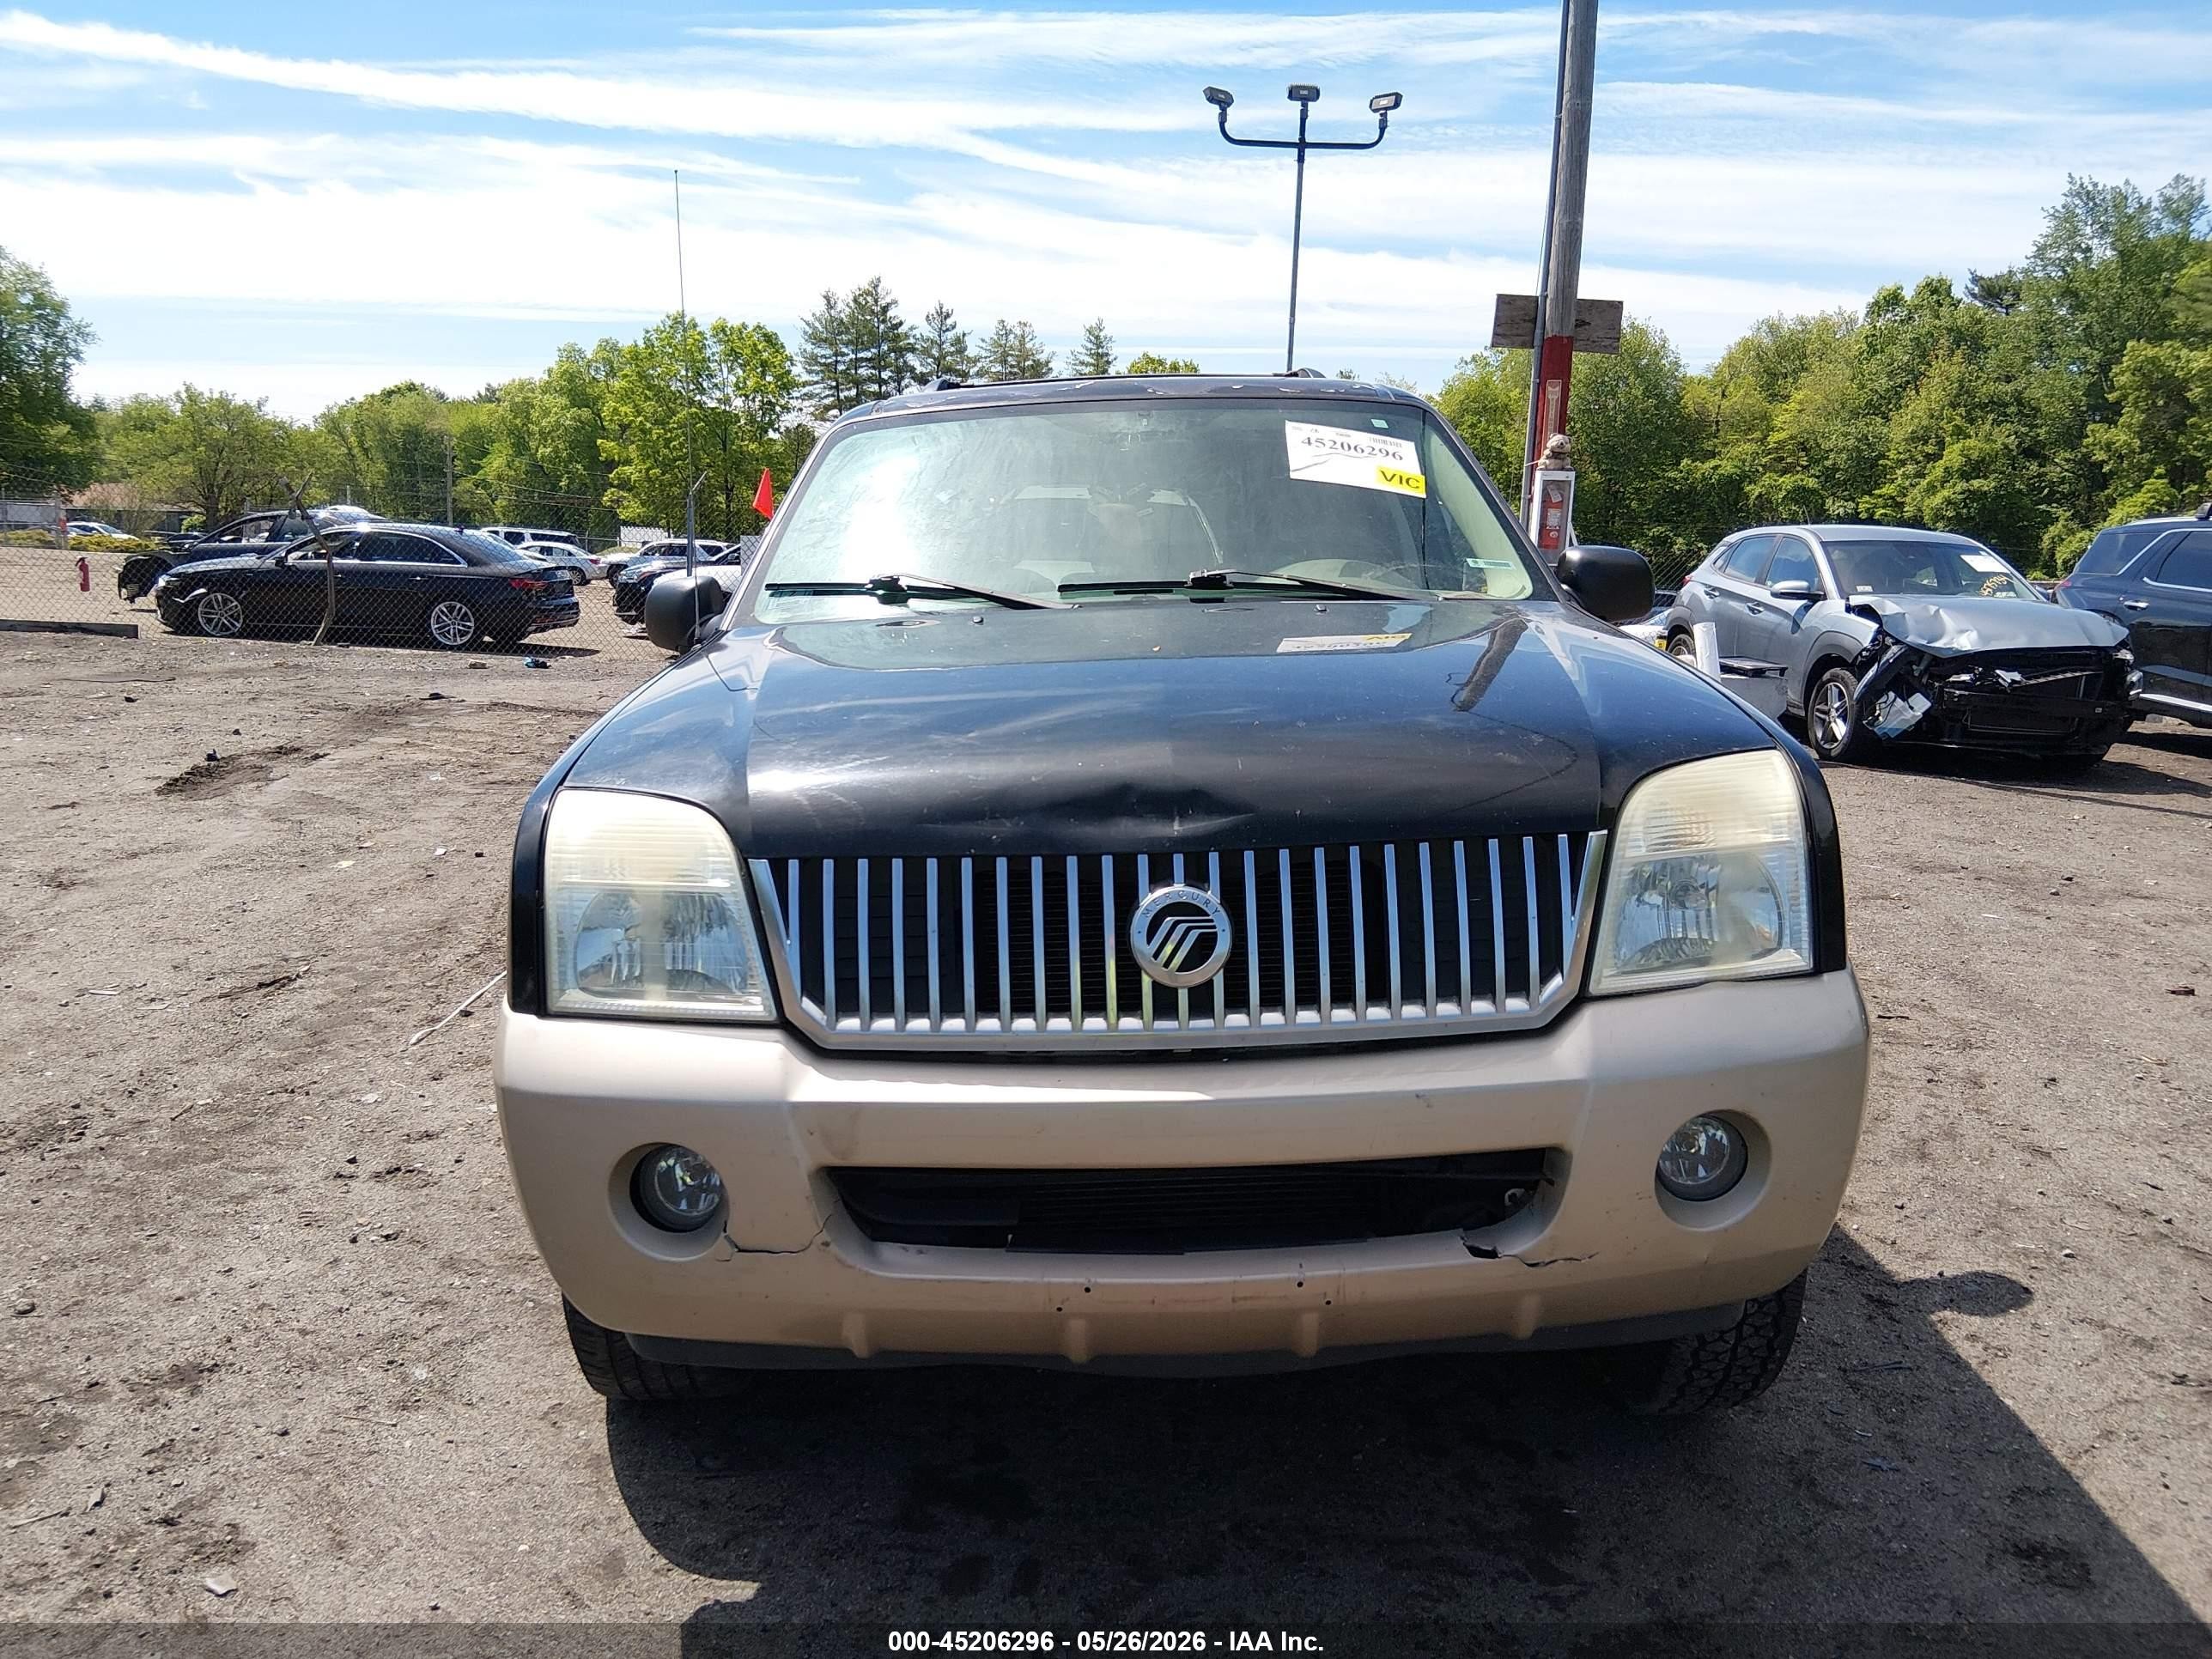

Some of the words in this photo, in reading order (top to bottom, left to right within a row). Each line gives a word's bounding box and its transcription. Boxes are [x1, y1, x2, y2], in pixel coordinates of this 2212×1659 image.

[1301, 436, 1404, 461] 45206296
[1380, 469, 1420, 489] VIC
[1142, 890, 1221, 919] MERCURY
